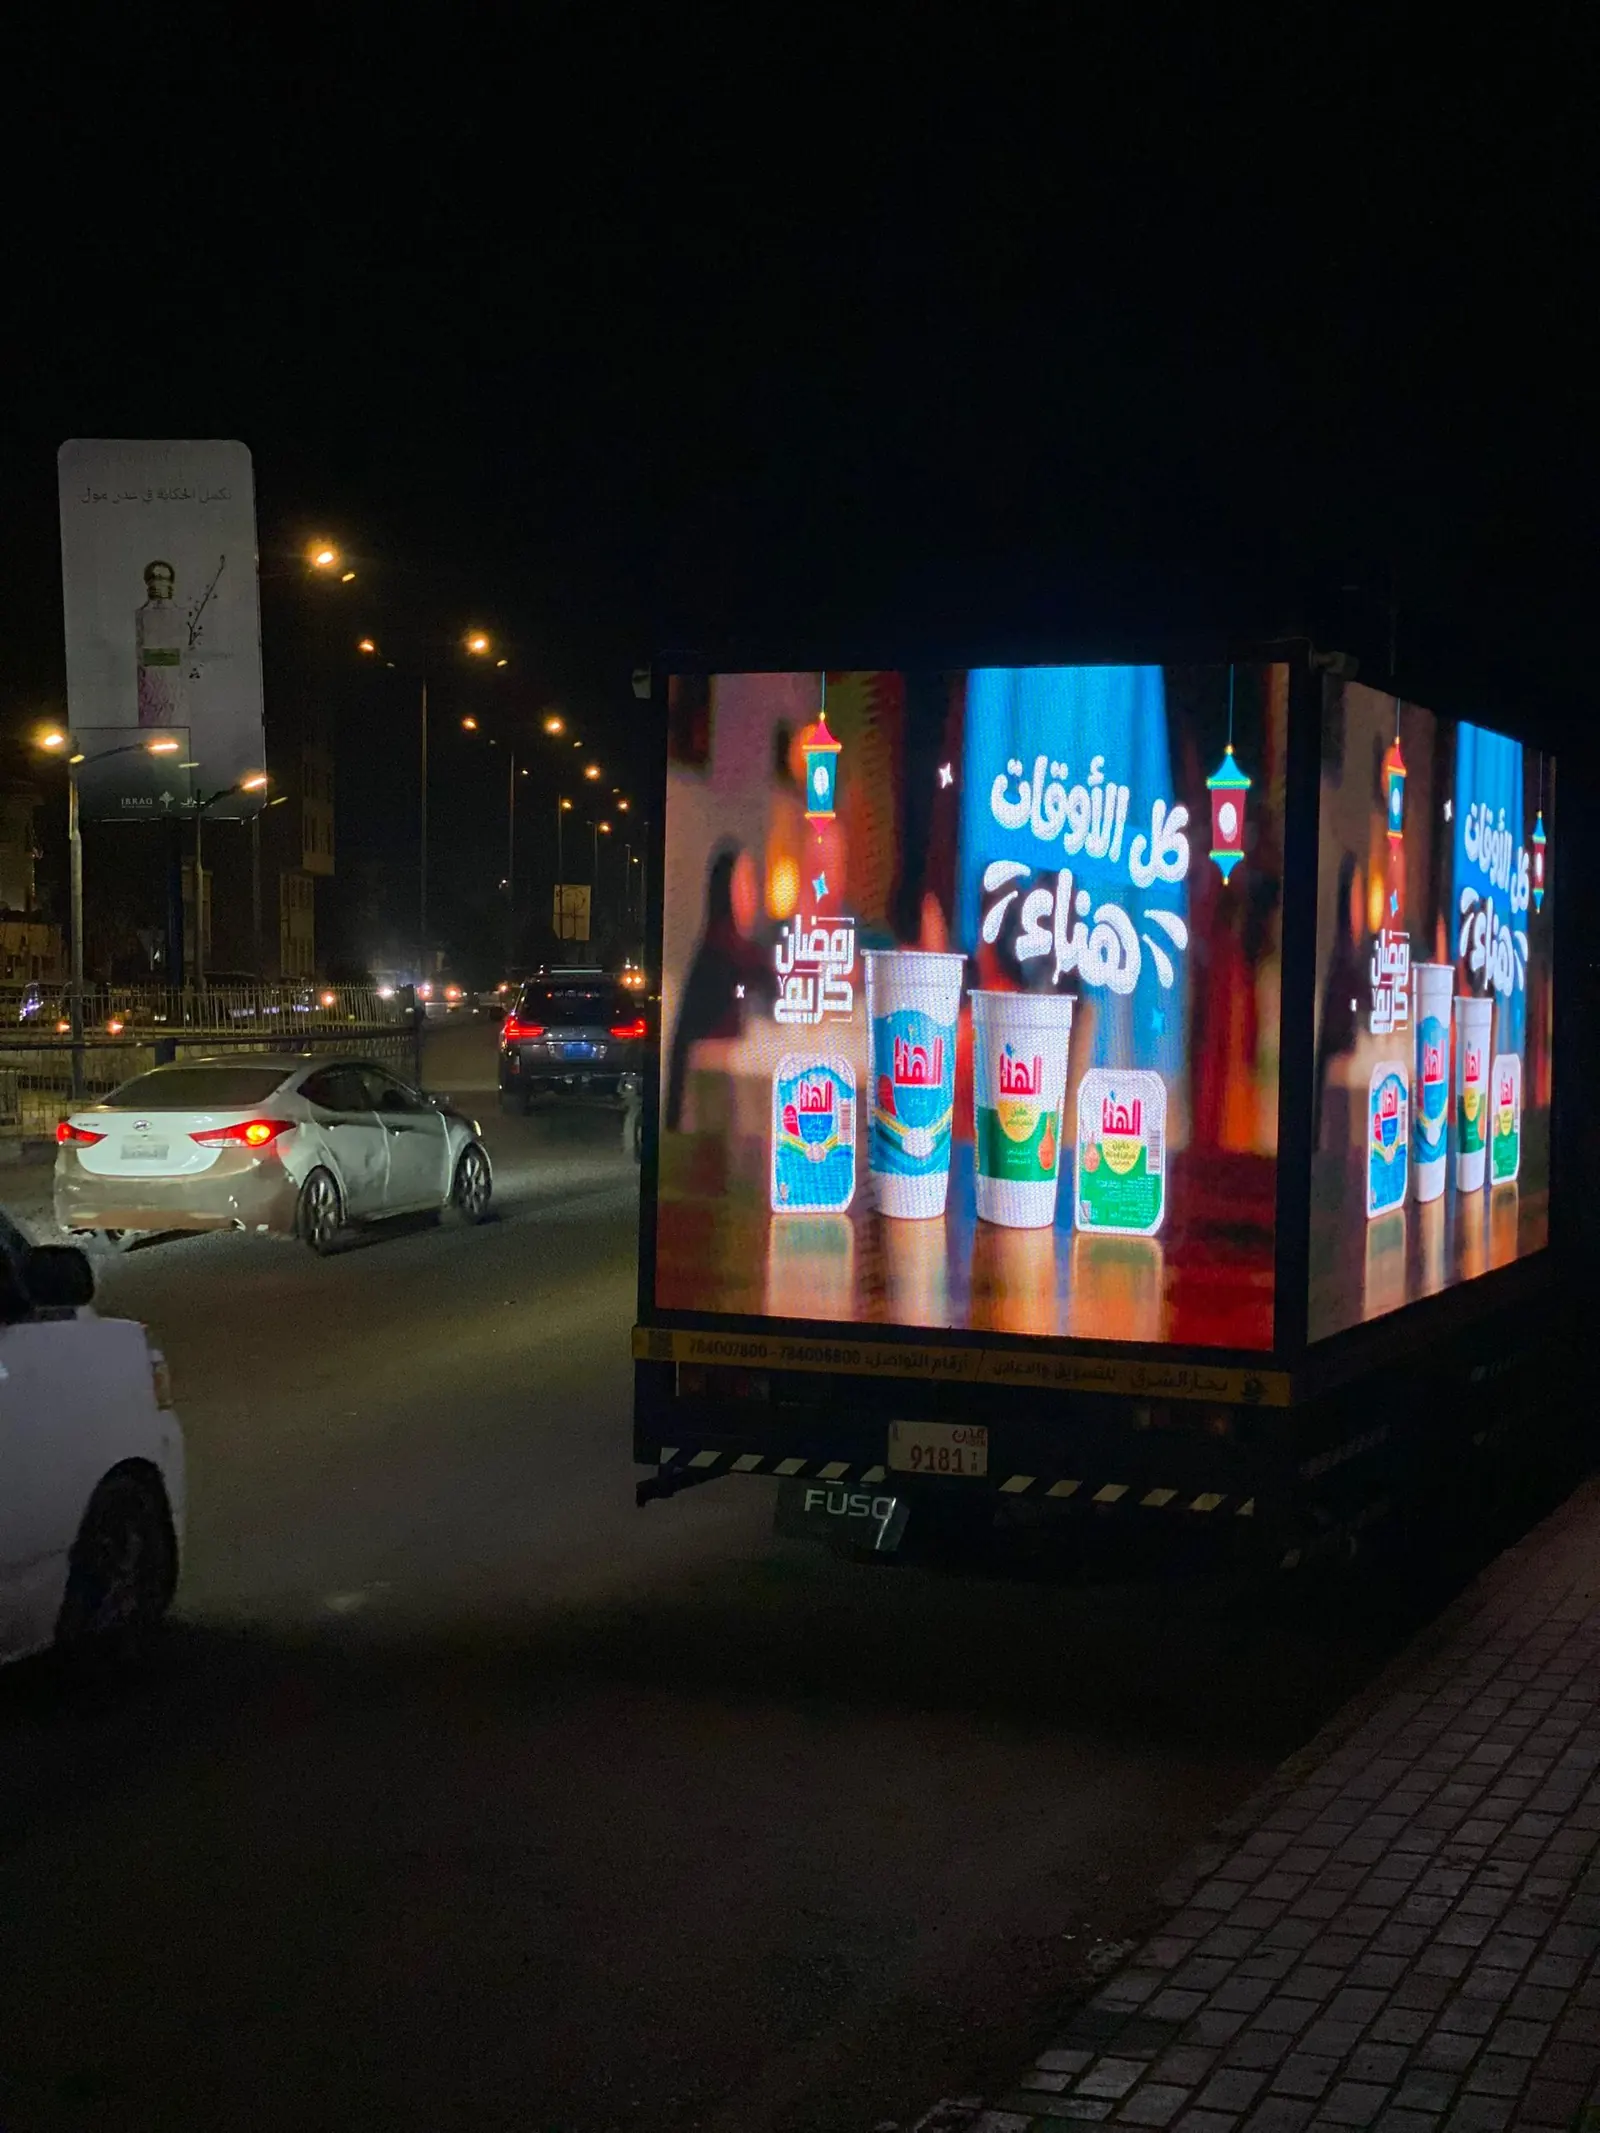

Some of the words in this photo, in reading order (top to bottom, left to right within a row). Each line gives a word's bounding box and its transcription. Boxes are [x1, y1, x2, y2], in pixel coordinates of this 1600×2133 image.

[991, 755, 1129, 863] الأوقات
[1128, 799, 1189, 888] كل
[1464, 802, 1511, 893] الأوقات
[1511, 846, 1529, 914] كل
[1015, 868, 1142, 995] هناء
[911, 1444, 963, 1473] 9181
[804, 1489, 895, 1521] FUSO
